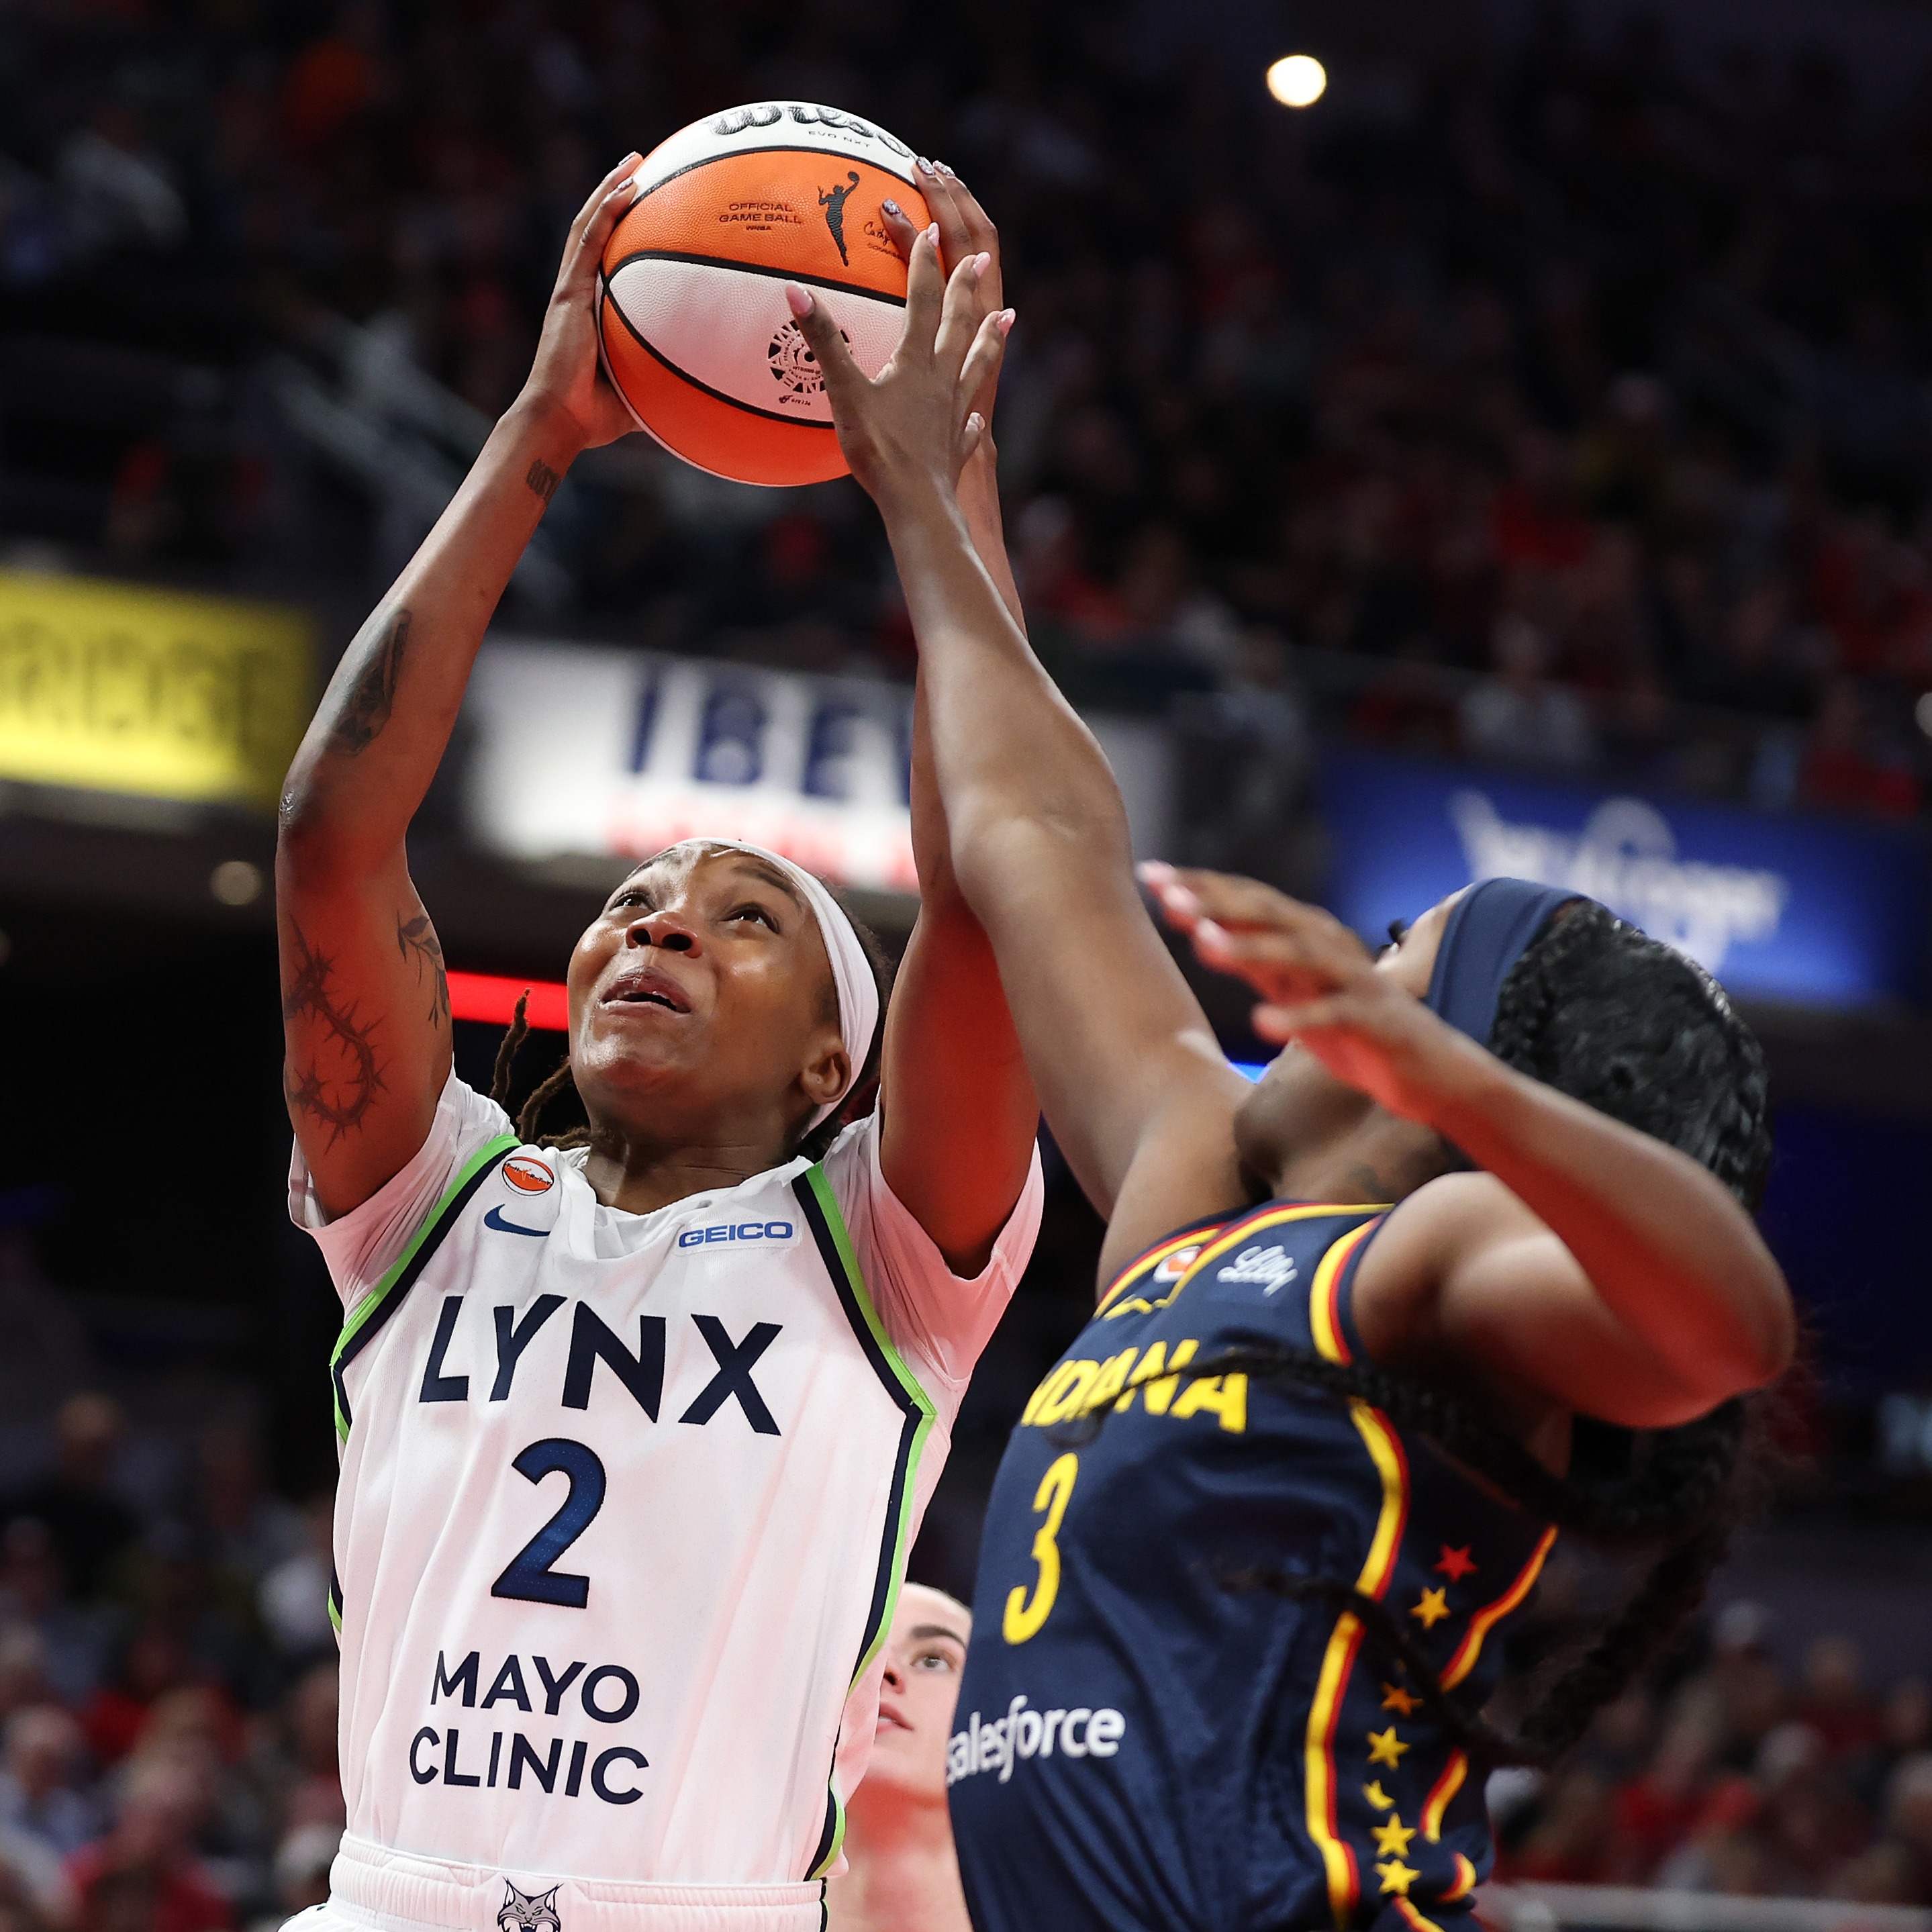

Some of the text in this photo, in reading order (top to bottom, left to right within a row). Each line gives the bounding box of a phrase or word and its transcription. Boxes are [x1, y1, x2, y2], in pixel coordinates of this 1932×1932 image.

[703, 105, 917, 161] Wilso
[843, 136, 870, 147] NXT
[719, 213, 802, 224] GAME BALL
[729, 203, 793, 211] OFFICIAL
[679, 1222, 793, 1247] GEICO
[419, 1294, 783, 1436] LYNX
[491, 1438, 606, 1609] 2
[1003, 1452, 1079, 1645] 3
[431, 1650, 640, 1723] MAYO
[409, 1726, 649, 1804] CLINIC
